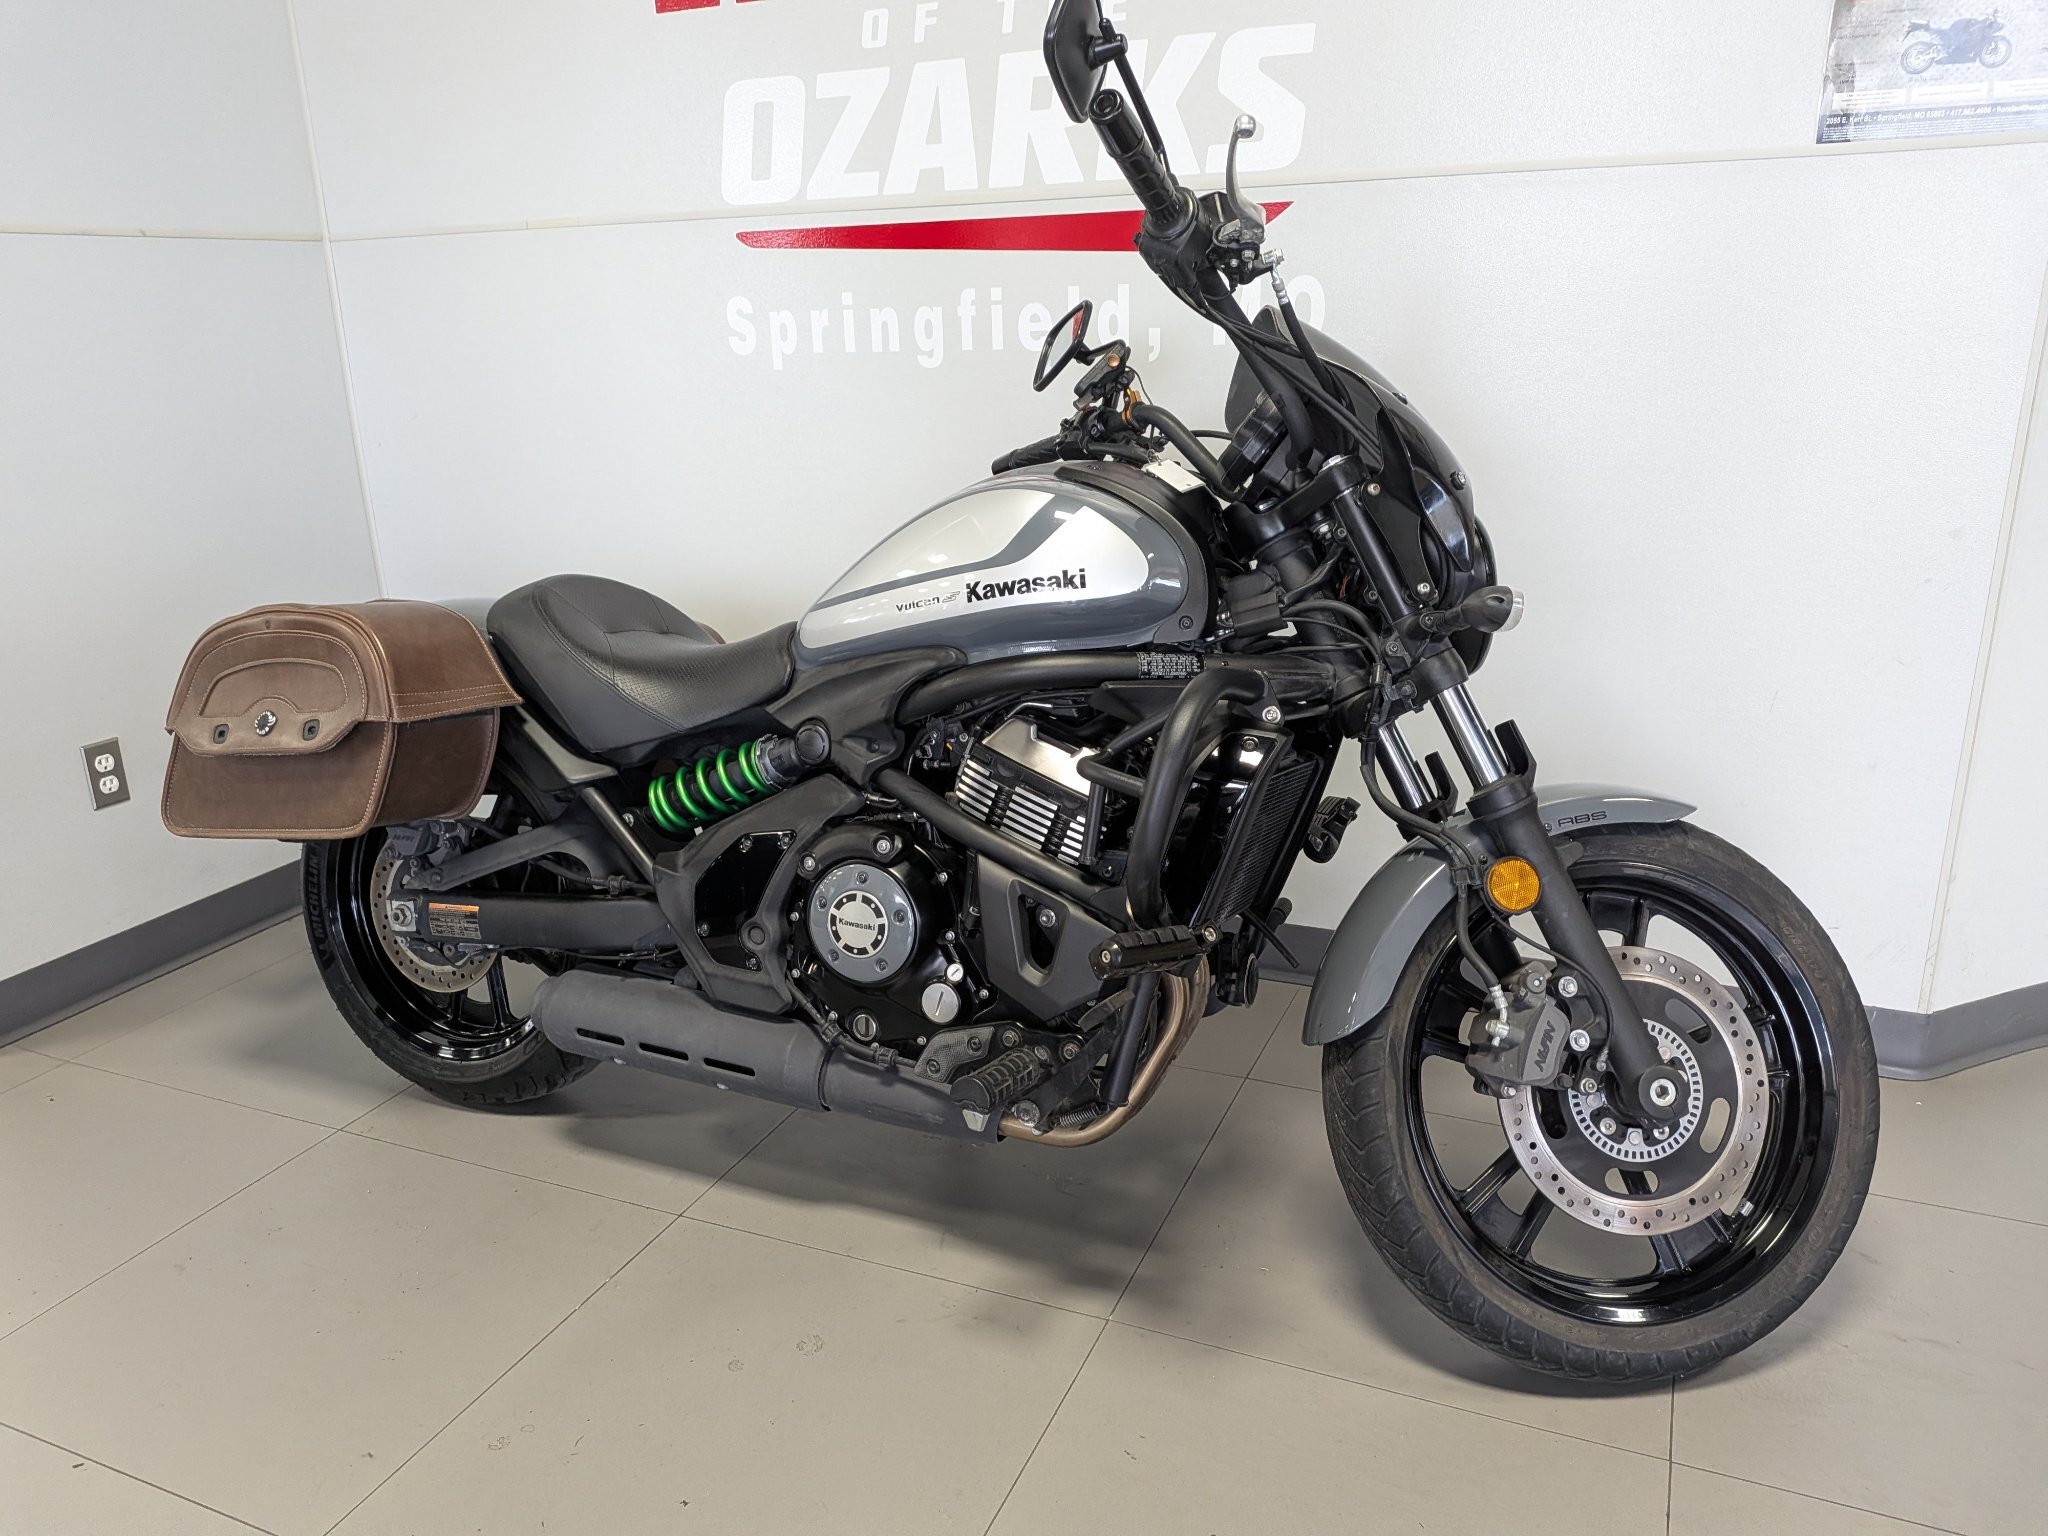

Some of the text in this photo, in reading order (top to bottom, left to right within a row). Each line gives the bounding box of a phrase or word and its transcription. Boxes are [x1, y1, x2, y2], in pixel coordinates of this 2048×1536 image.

[861, 0, 1127, 49] OF TE
[720, 23, 1317, 206] OZARKS
[965, 568, 1087, 603] Kawasaki
[1557, 810, 1608, 828] ABS
[308, 858, 325, 939] MICHELIN
[838, 916, 876, 932] Kawasaki
